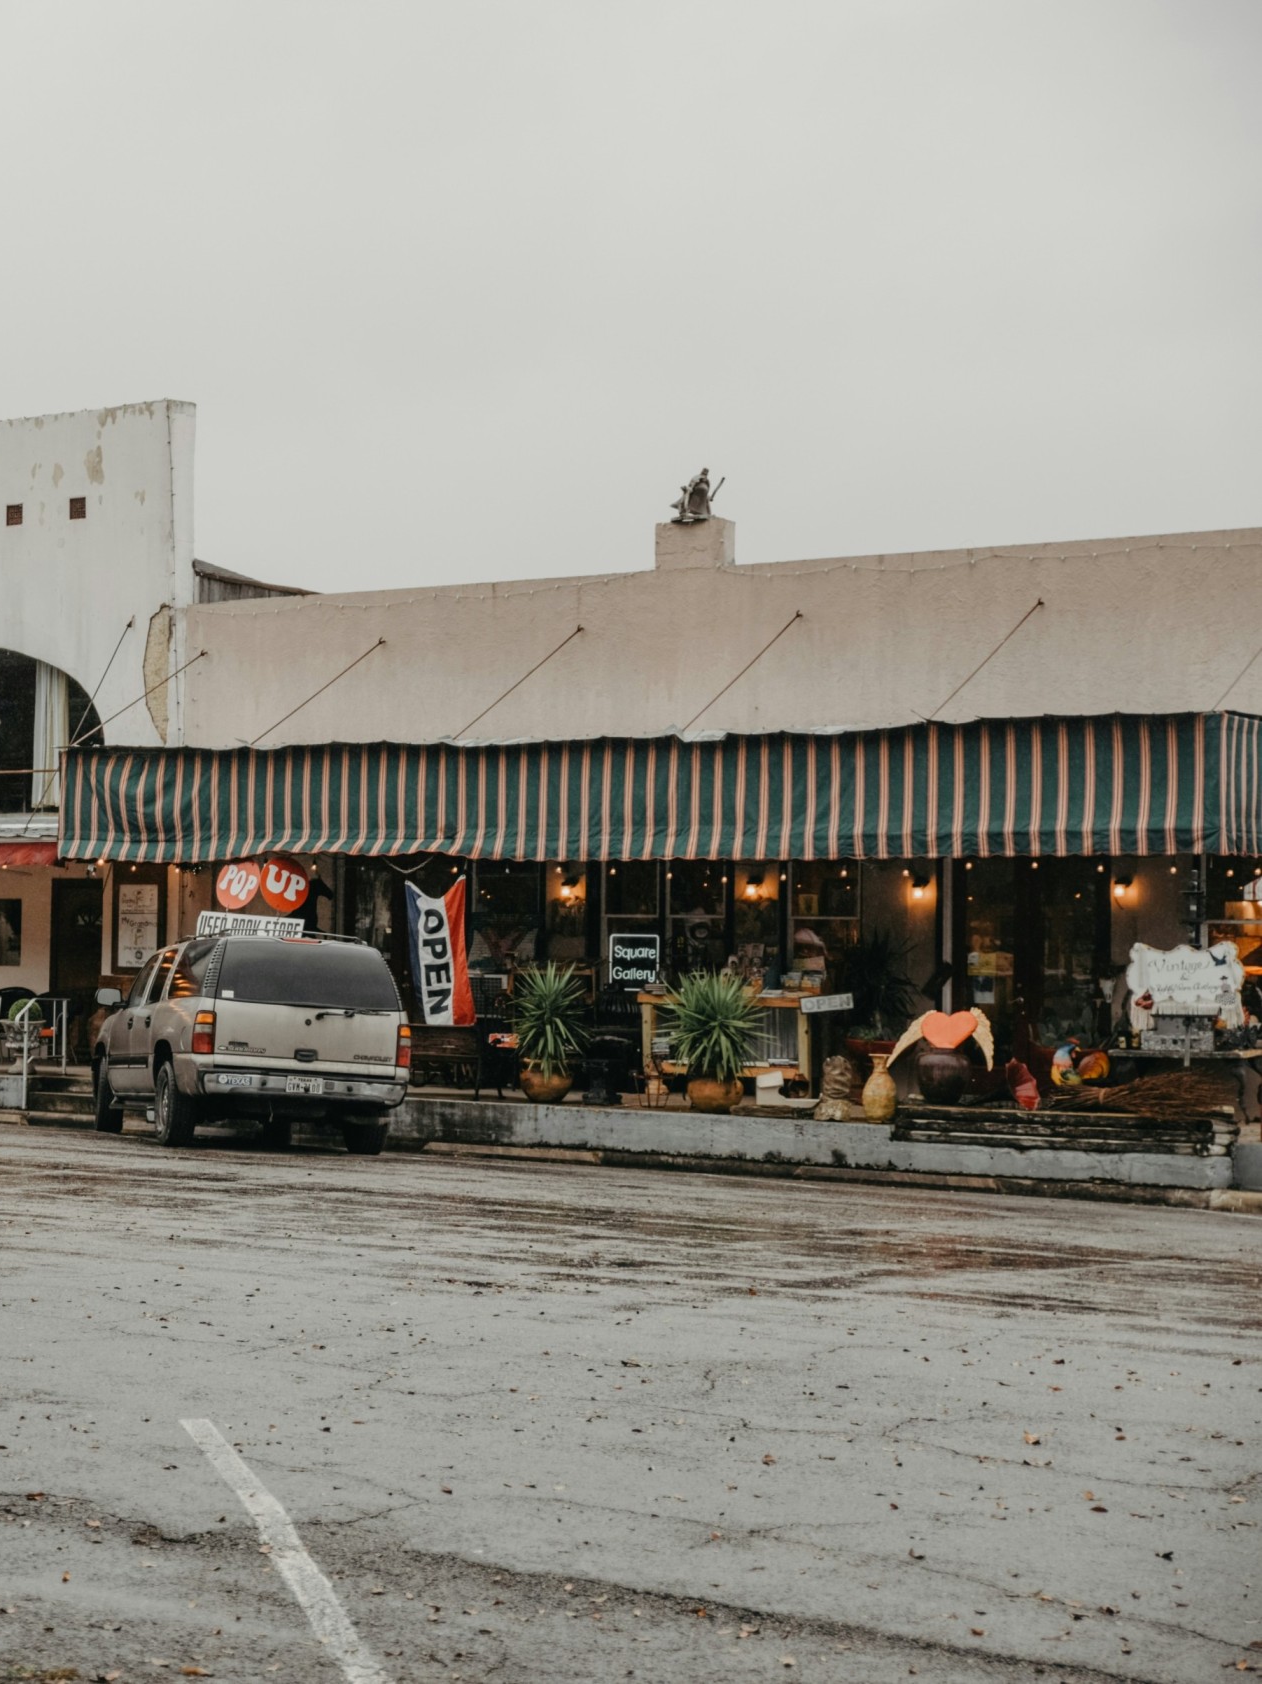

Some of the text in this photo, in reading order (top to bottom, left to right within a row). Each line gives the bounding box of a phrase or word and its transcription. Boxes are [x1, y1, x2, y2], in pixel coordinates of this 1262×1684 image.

[219, 864, 258, 900] POP
[266, 864, 306, 901] UP
[199, 915, 300, 938] USED BOOK STORE
[423, 908, 453, 1015] OPEN
[614, 945, 656, 961] Square
[612, 966, 656, 983] Gallery
[804, 996, 851, 1010] OPEN
[226, 1076, 251, 1086] TEXAS
